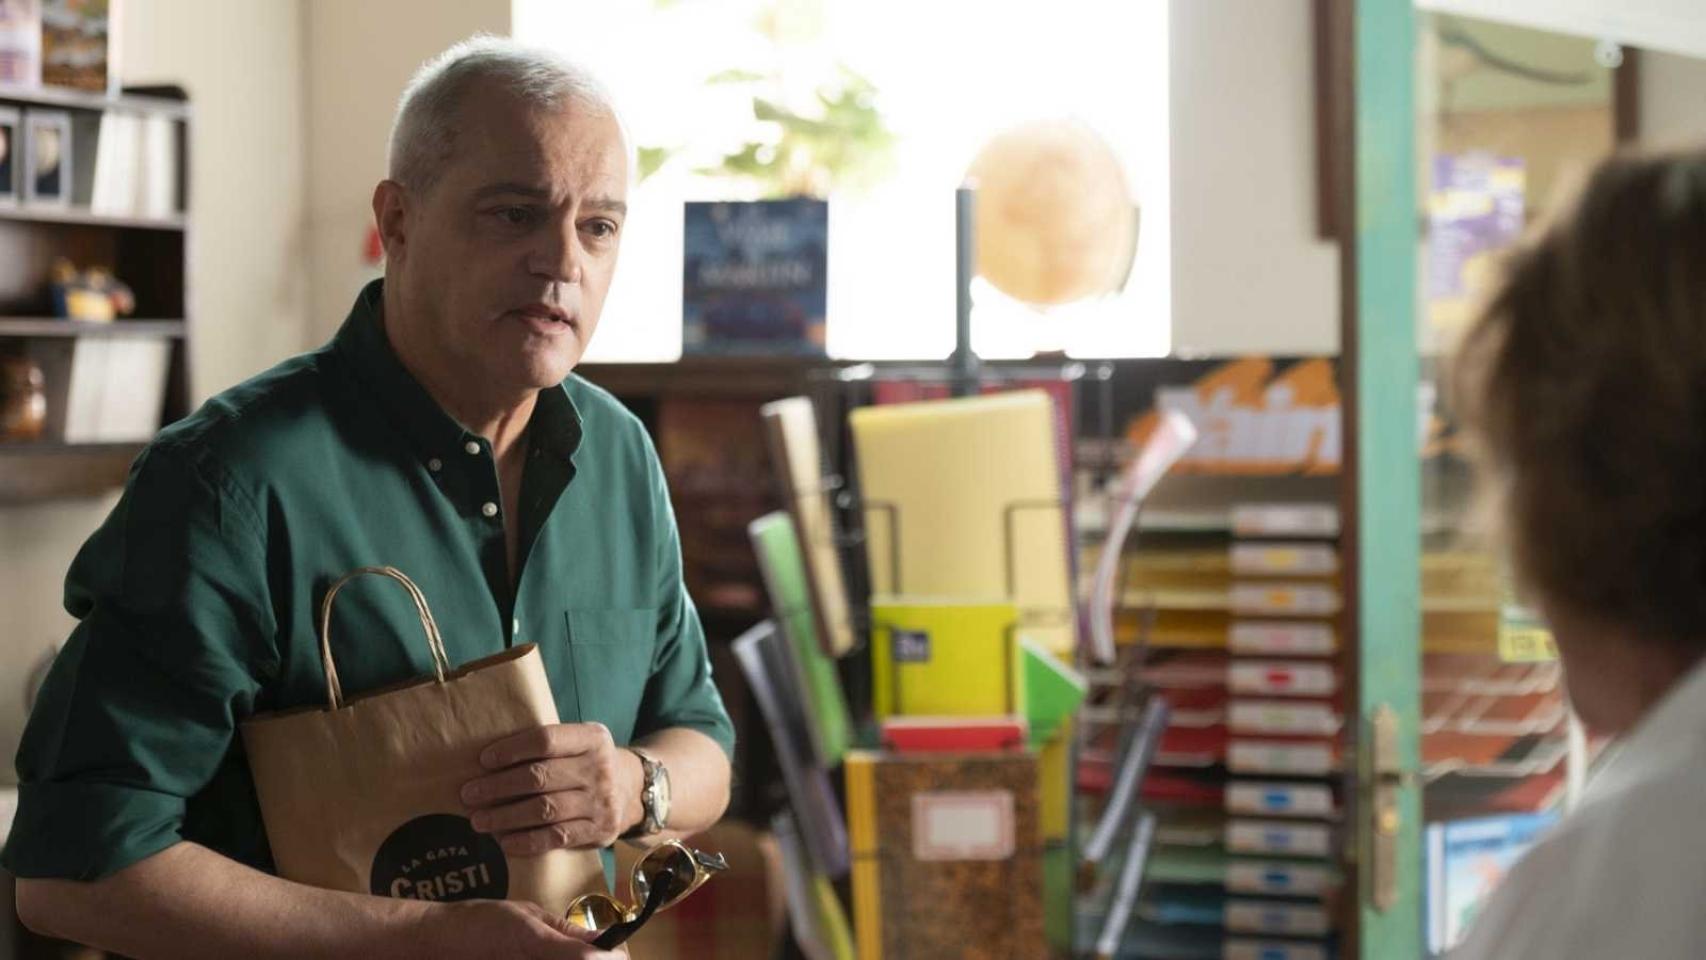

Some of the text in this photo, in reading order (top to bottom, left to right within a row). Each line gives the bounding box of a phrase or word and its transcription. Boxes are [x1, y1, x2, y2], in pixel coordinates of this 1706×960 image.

[401, 846, 469, 873] LA GATA
[390, 863, 490, 900] CRISTI
